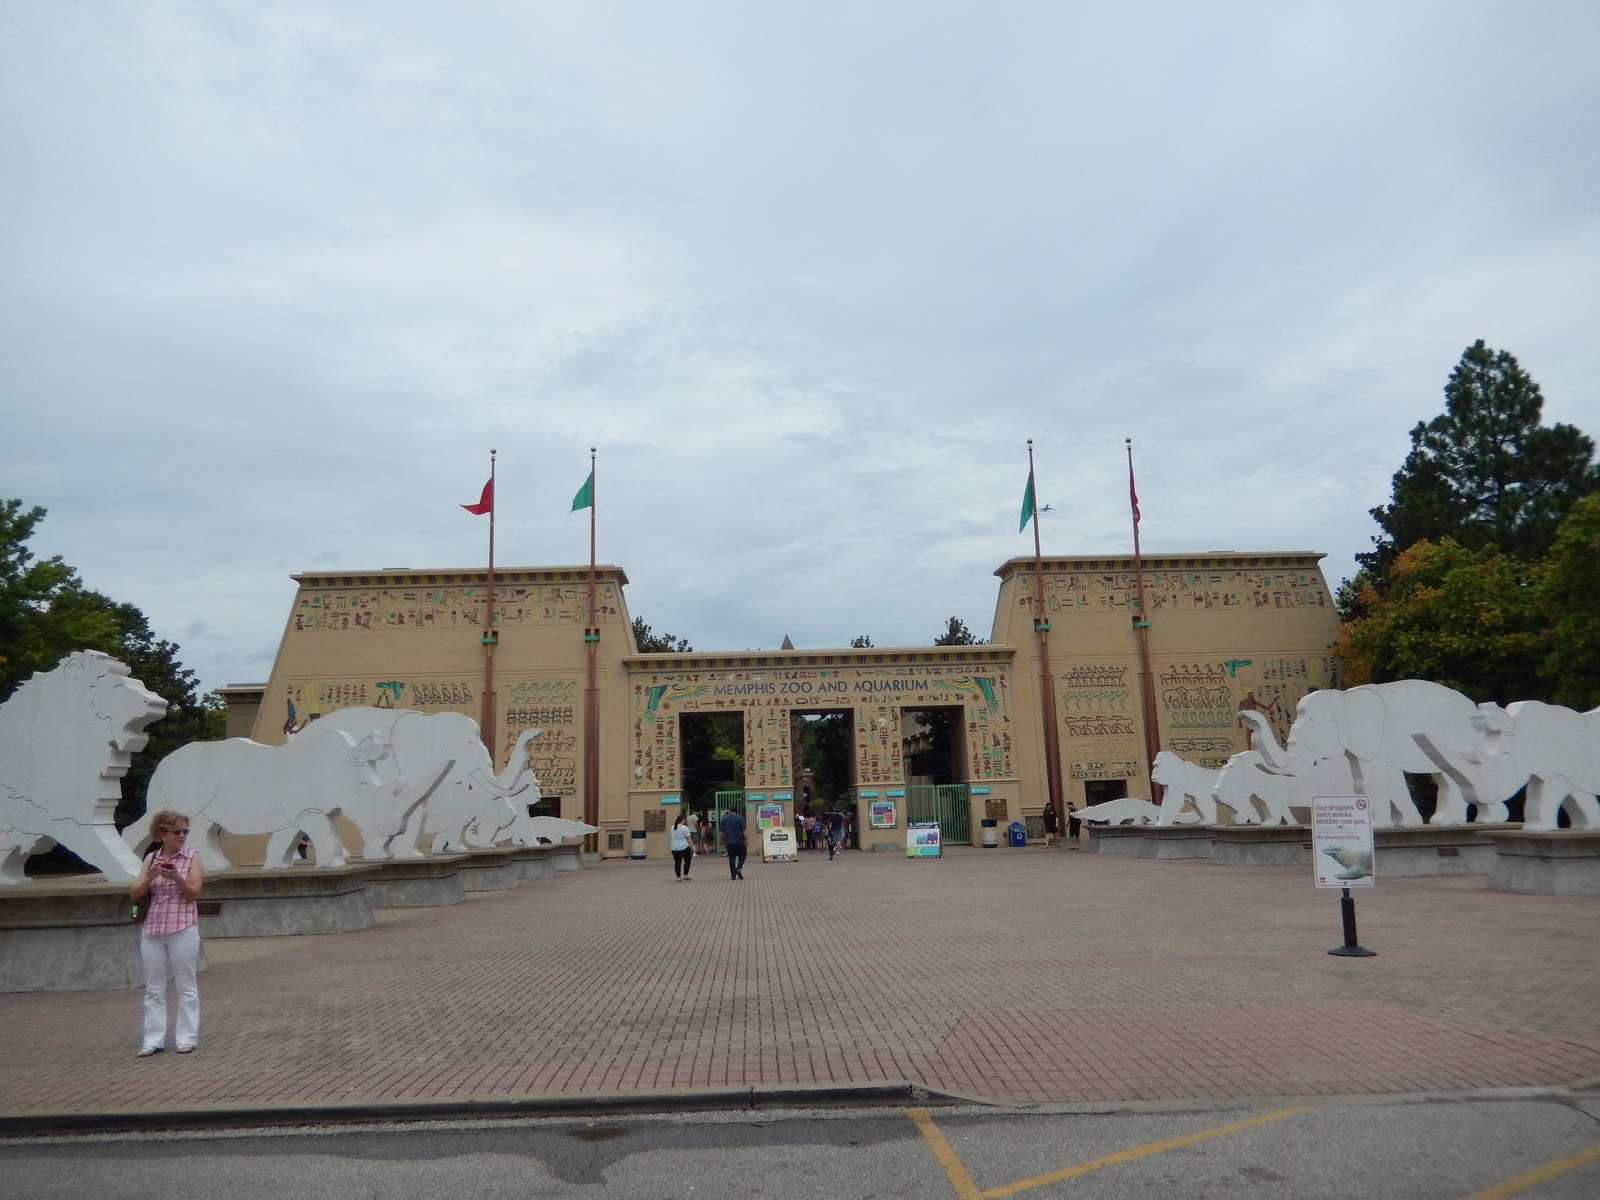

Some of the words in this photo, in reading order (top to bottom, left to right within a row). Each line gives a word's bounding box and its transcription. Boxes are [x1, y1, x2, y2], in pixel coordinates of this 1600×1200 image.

[714, 683, 775, 696] MEMPHIS
[780, 681, 813, 694] ZOO
[818, 681, 848, 693] AND
[853, 679, 929, 692] AQUARIUM
